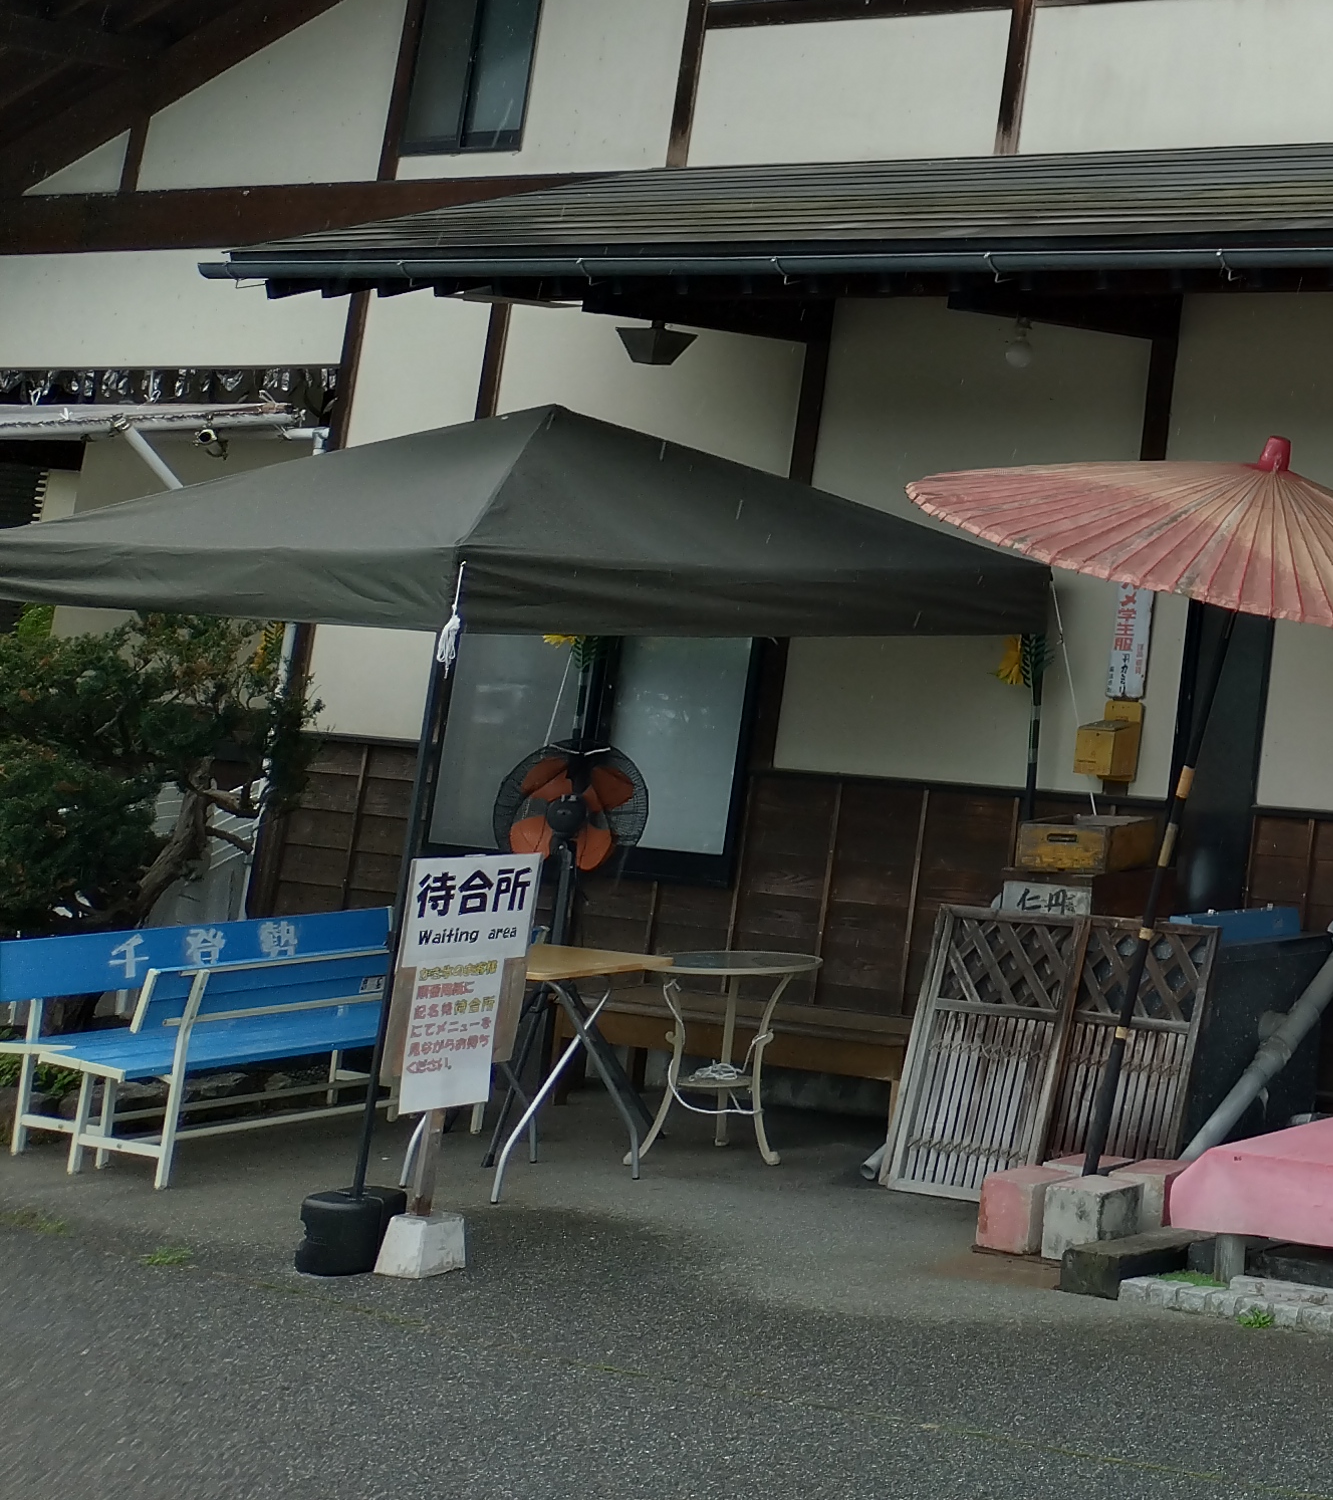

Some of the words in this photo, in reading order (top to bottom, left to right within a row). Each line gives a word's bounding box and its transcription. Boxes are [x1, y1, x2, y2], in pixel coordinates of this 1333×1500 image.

[416, 866, 532, 919] 待合所
[418, 927, 480, 946] Waiting
[488, 926, 517, 940] area
